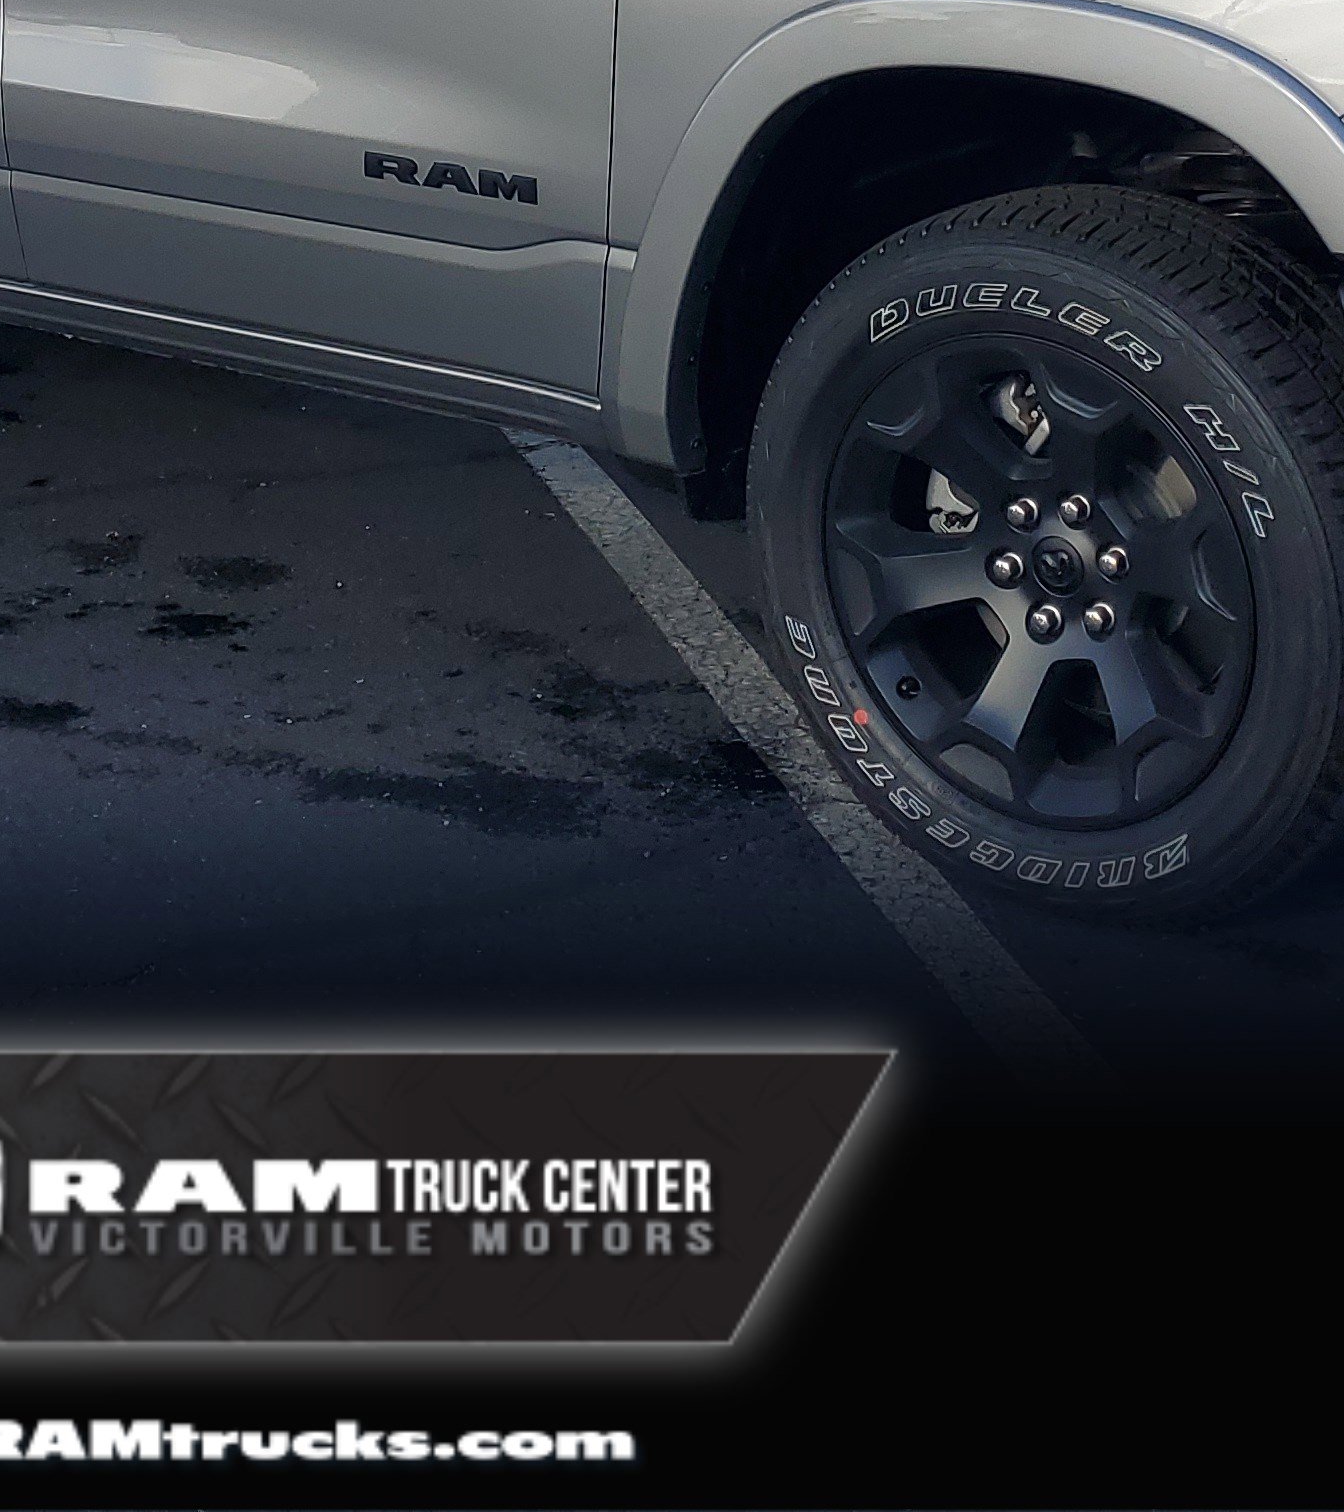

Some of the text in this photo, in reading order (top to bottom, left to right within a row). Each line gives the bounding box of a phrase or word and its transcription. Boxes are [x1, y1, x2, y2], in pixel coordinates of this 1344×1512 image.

[364, 150, 538, 206] RAM
[870, 283, 1276, 538] DUELER H/L
[784, 614, 1189, 888] BRIDGESTONE
